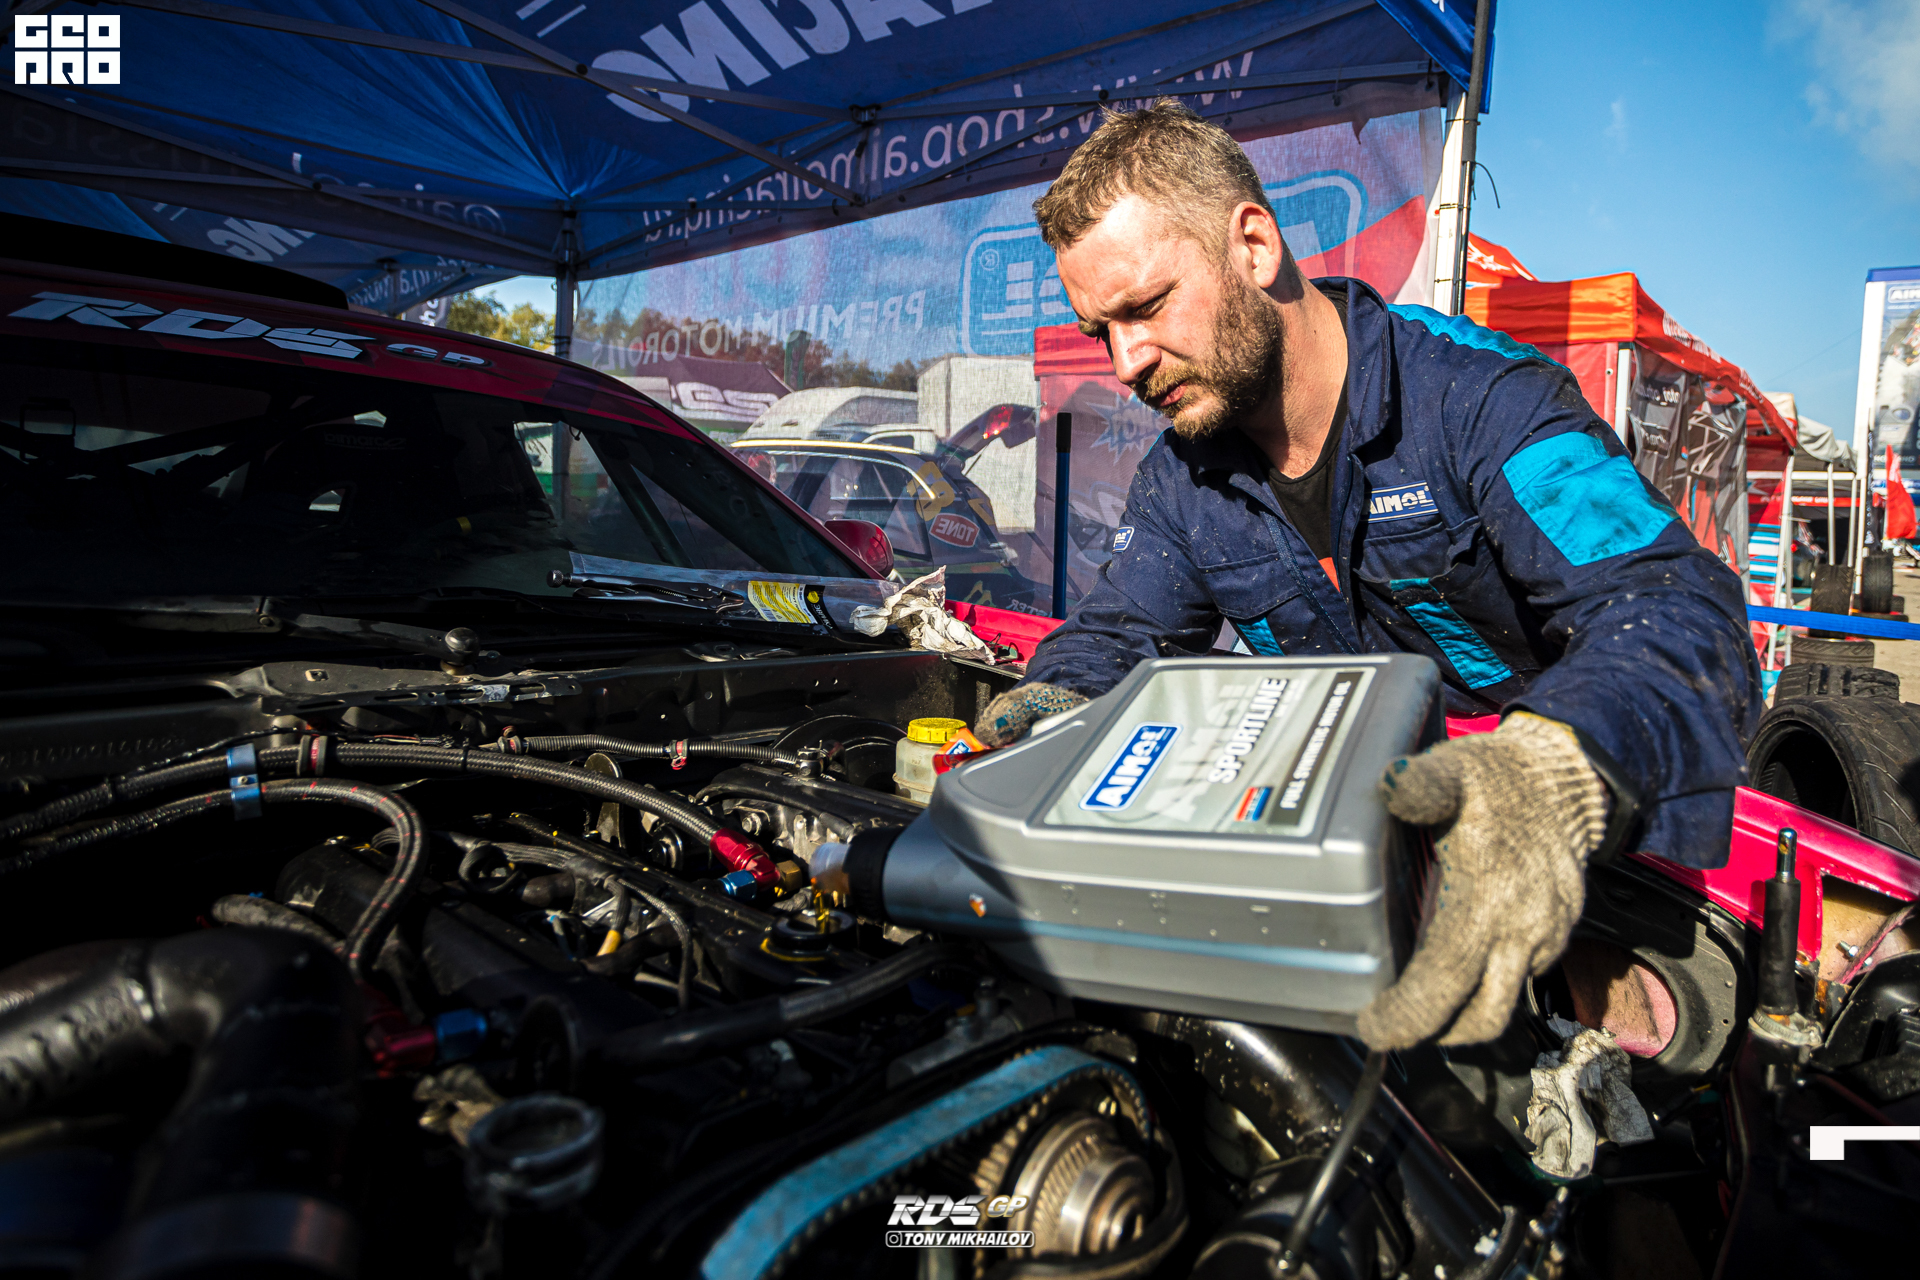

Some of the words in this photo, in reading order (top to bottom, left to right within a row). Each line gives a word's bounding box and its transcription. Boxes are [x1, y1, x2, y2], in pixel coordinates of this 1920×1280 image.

[7, 290, 377, 360] RDS
[385, 342, 490, 367] GP
[1096, 727, 1168, 808] AIMOL
[1207, 678, 1289, 784] SPORTLINE
[1280, 779, 1306, 808] FULL
[1293, 726, 1329, 780] SYNTHETIC
[1318, 695, 1345, 727] MOTOR
[1333, 680, 1352, 696] OIL
